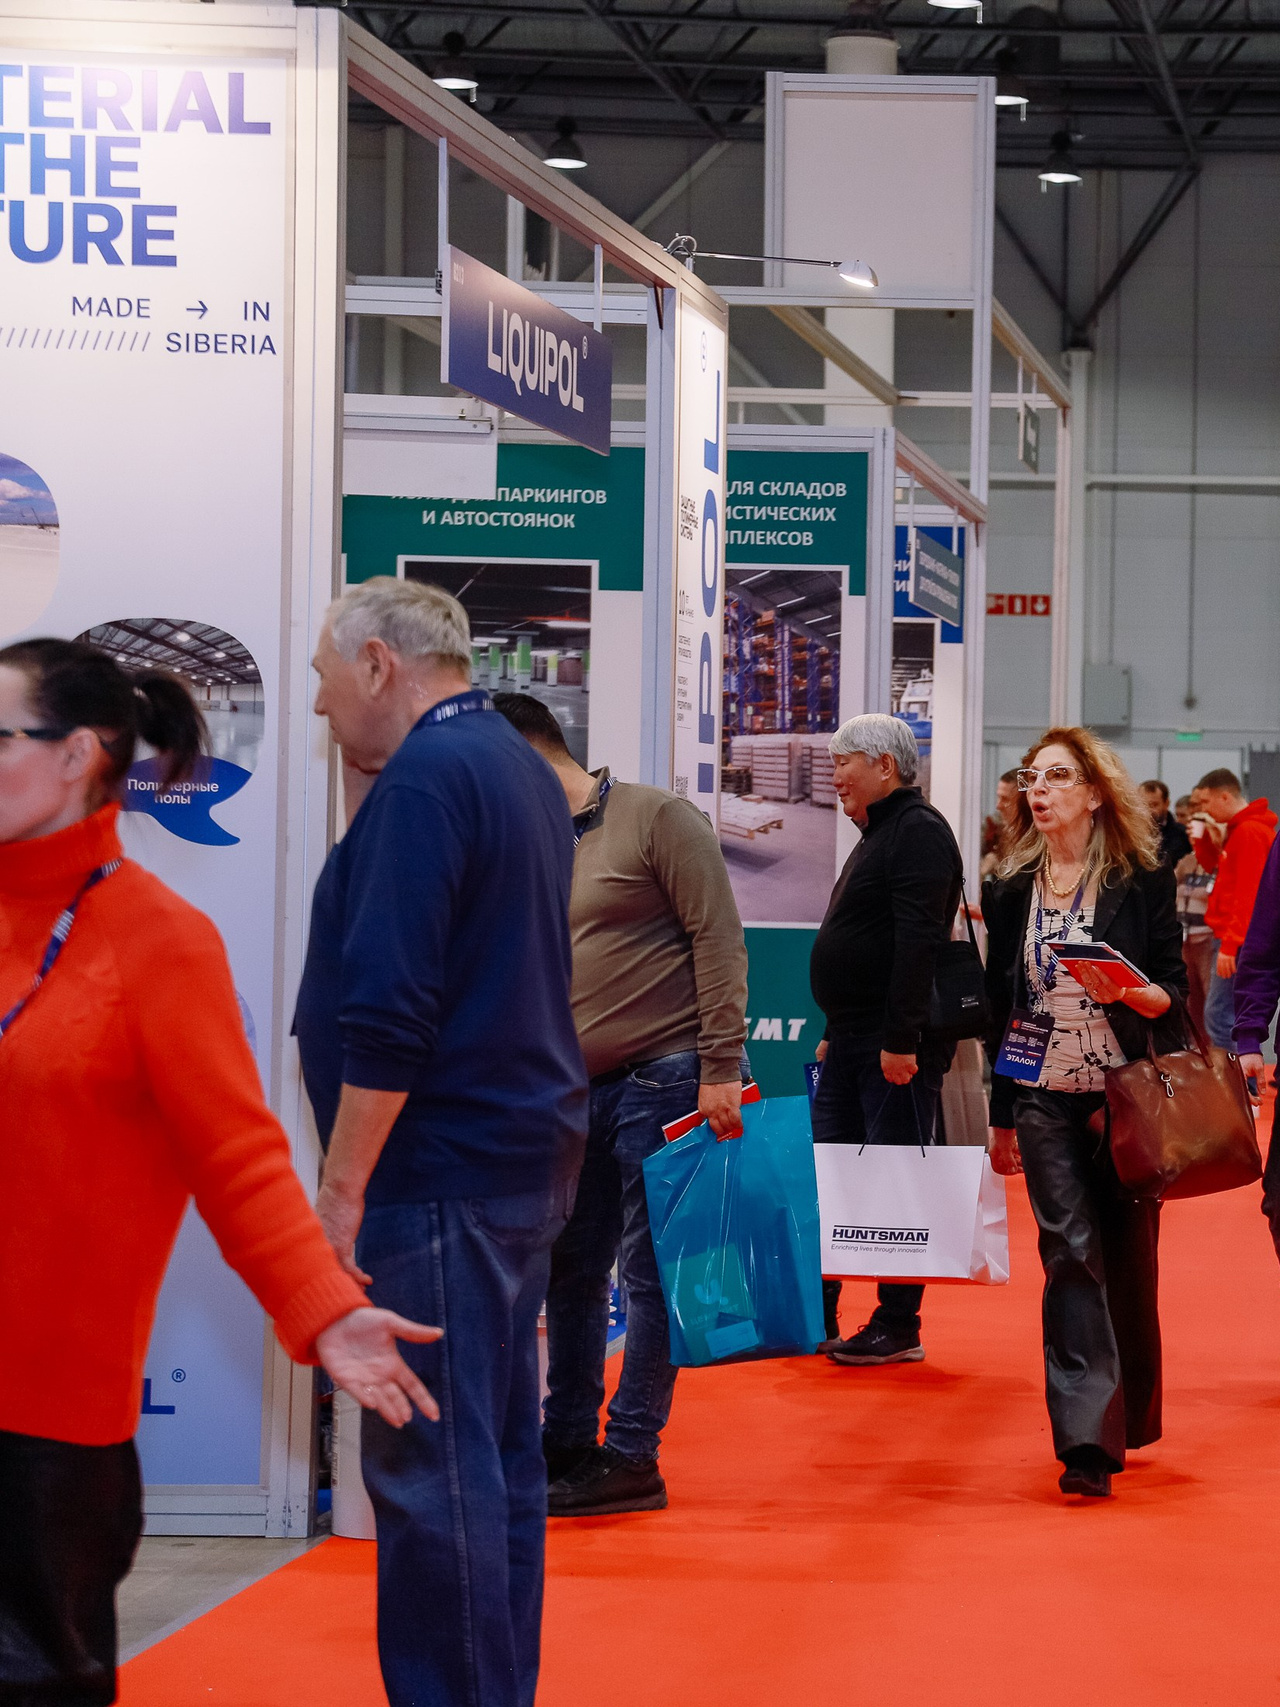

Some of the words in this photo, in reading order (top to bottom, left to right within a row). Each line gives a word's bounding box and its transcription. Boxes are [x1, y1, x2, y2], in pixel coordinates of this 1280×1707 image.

[0, 200, 178, 267] URE
[72, 296, 151, 319] MADE
[243, 301, 270, 321] IN
[166, 332, 277, 355] SIBERIA
[497, 487, 607, 505] ПАРКИНГОВ
[726, 480, 754, 498] ЛЯ
[758, 481, 848, 500] СКЛАДОВ
[422, 510, 436, 525] И
[440, 511, 576, 529] АВТОСТОЯНОК
[725, 530, 814, 546] ПЛЕКСОВ
[1006, 1053, 1037, 1067] ЭТАЛОН
[832, 1228, 930, 1242] HUNTSMAN
[831, 1244, 858, 1252] Enriching
